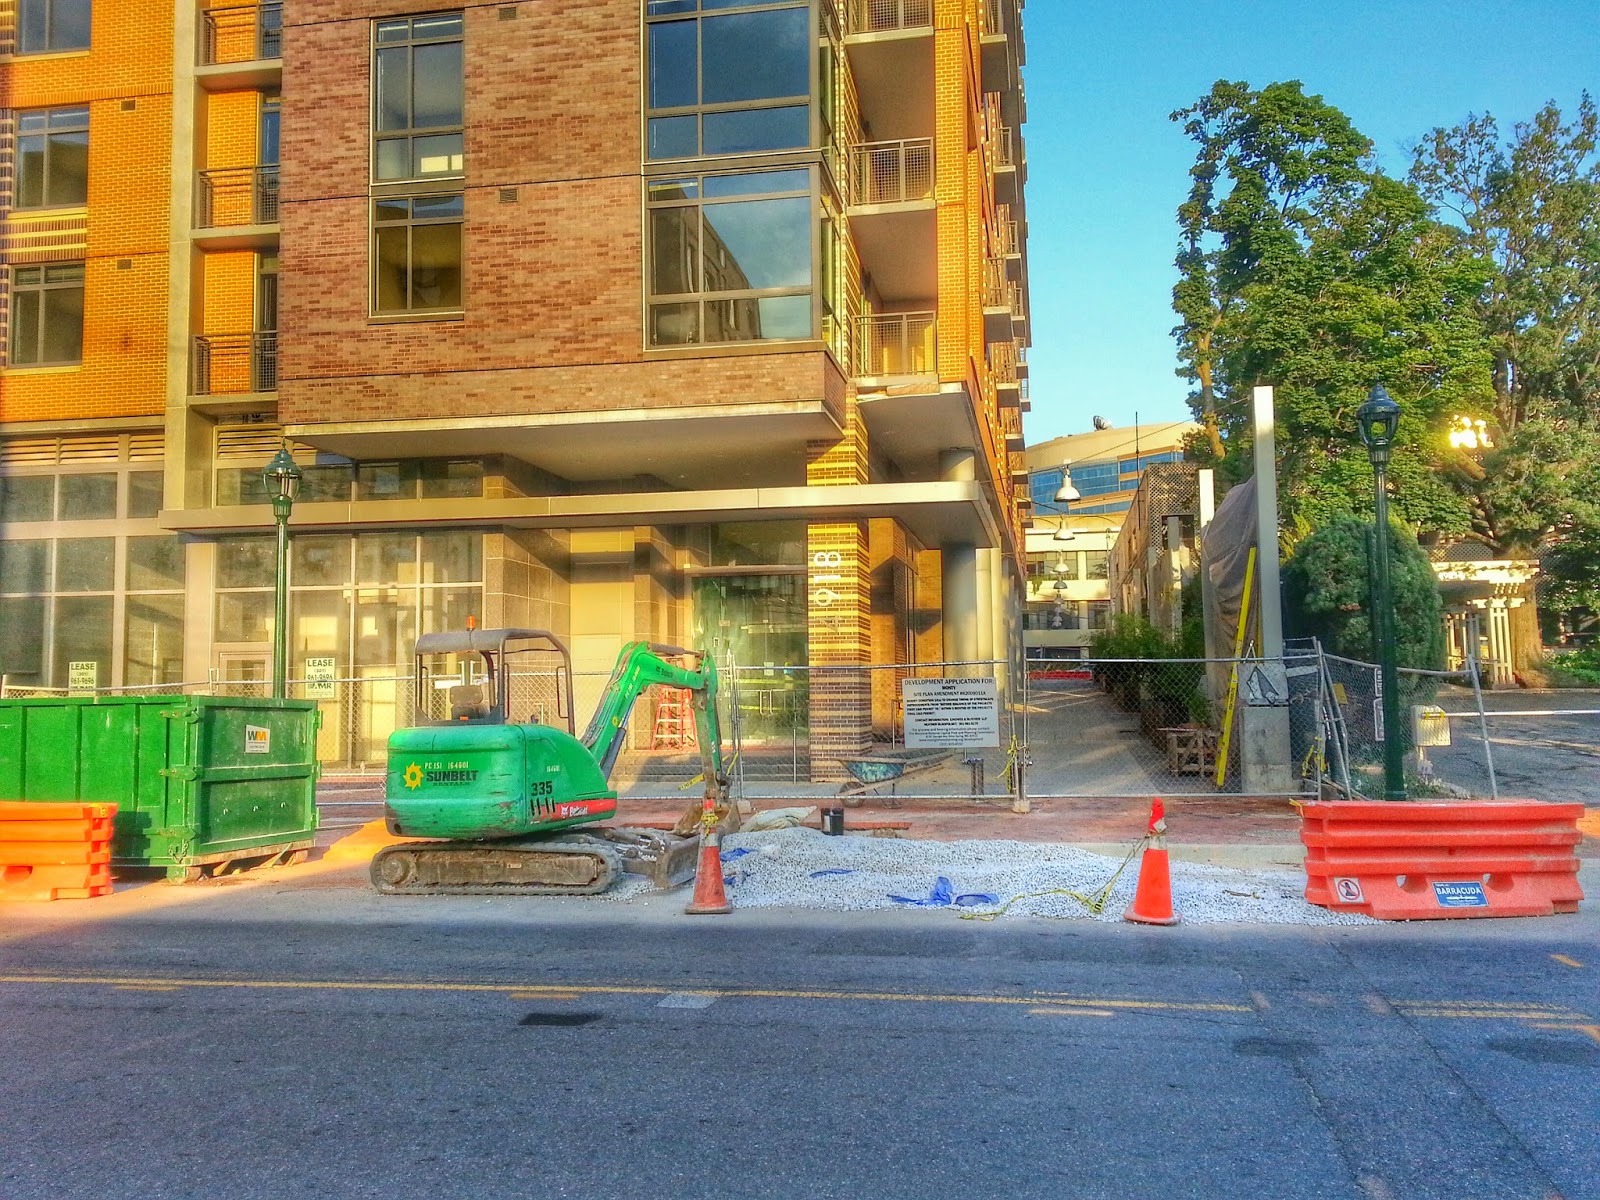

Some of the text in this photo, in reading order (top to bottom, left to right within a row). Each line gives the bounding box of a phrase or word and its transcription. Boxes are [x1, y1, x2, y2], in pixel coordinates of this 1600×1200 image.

[813, 551, 842, 632] 4918
[70, 663, 95, 671] LEASE
[307, 659, 333, 667] LEASE
[70, 677, 95, 685] 961-9696
[904, 678, 944, 686] DEVELOPMENT
[944, 677, 981, 685] APPLICATION
[247, 730, 267, 741] WM
[426, 770, 479, 782] SUNBELT
[531, 780, 553, 797] 335
[1436, 886, 1482, 895] BARRACUDA
